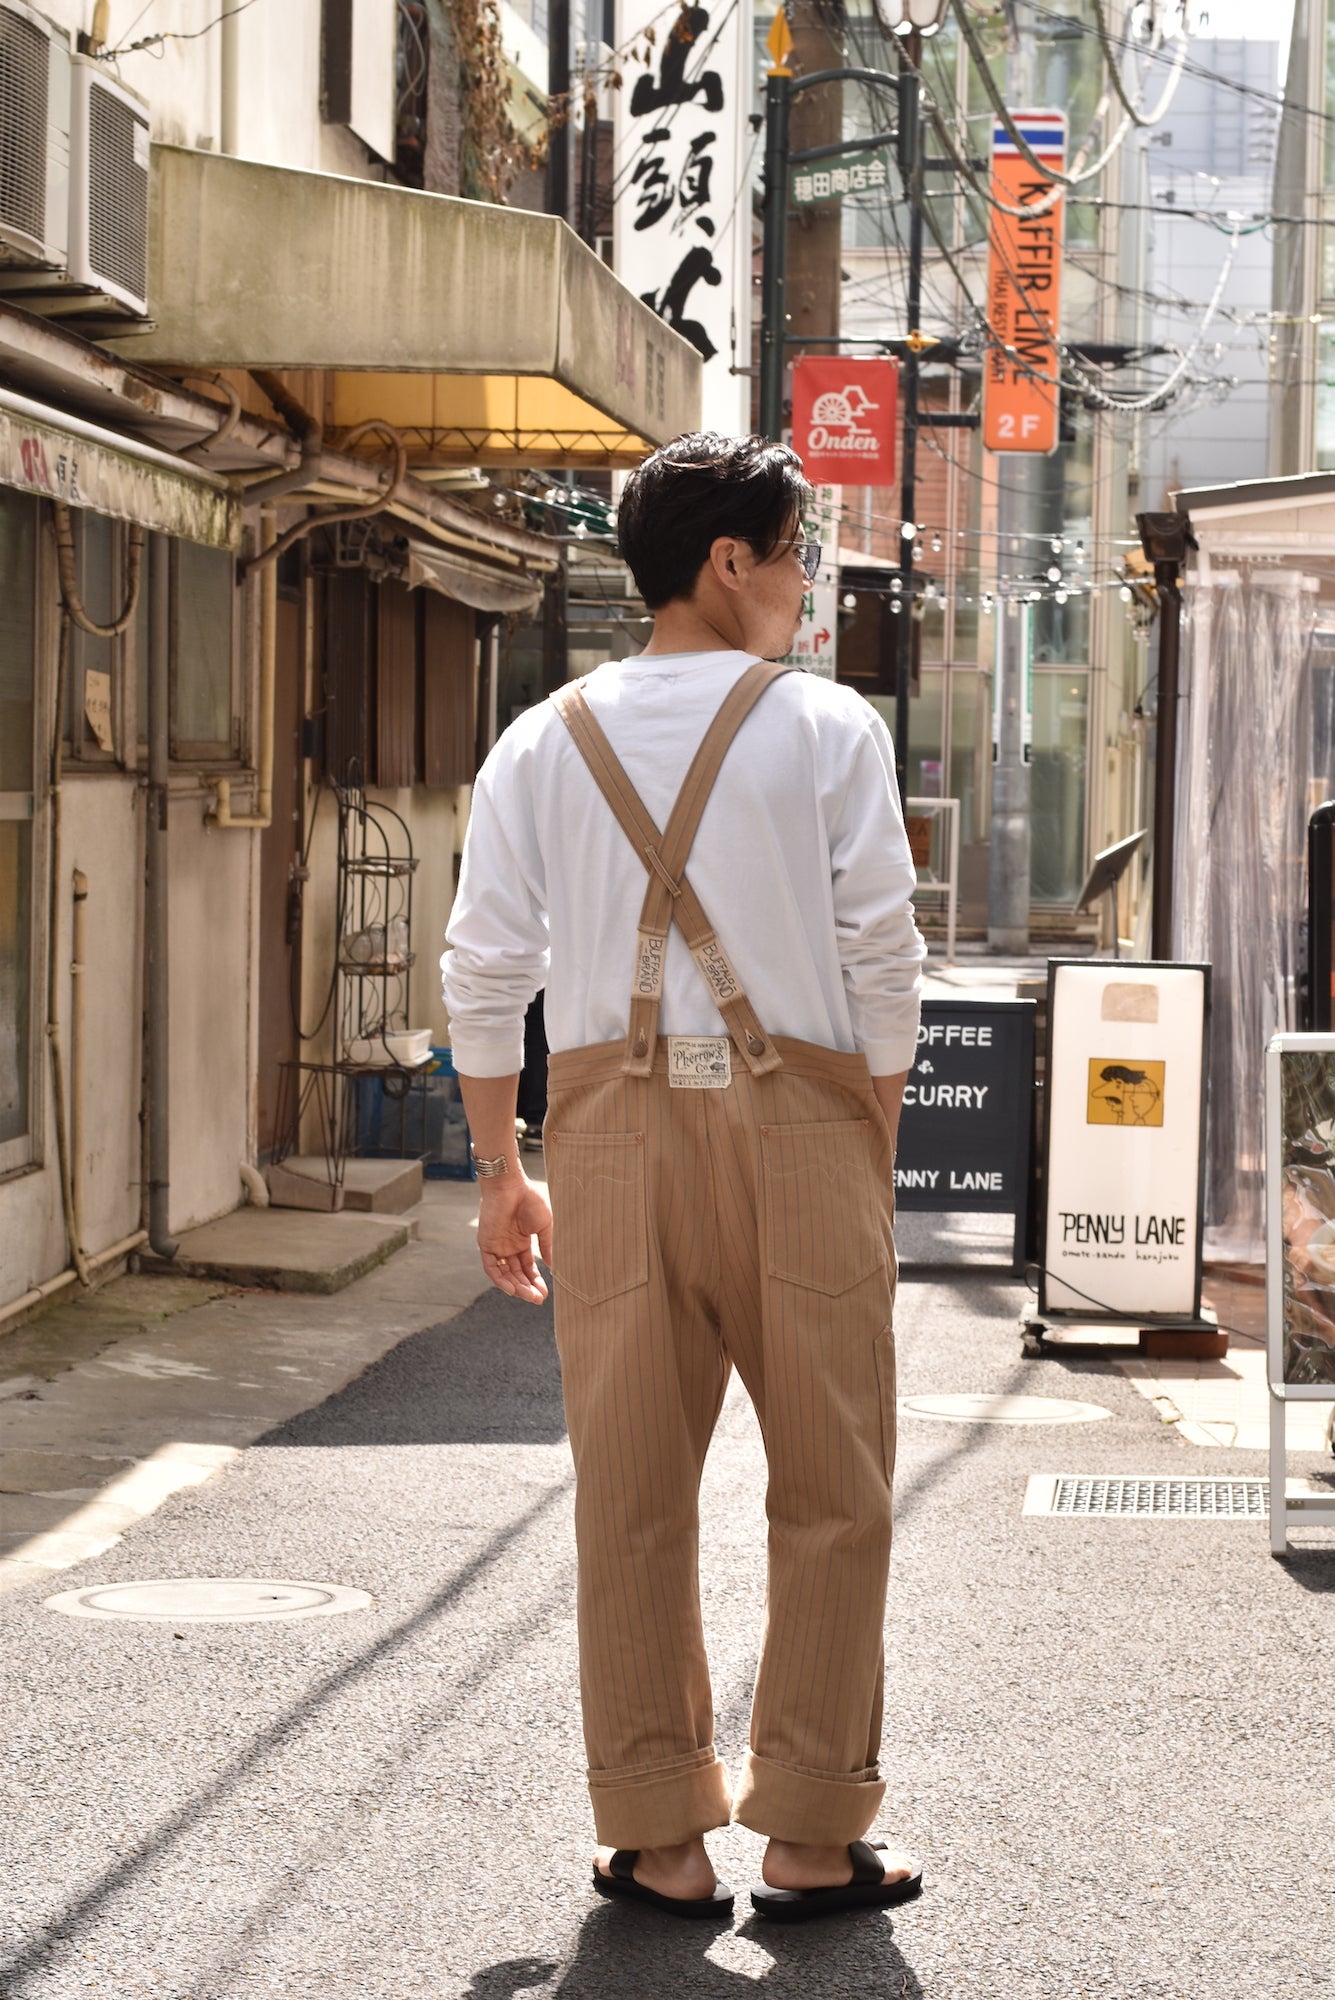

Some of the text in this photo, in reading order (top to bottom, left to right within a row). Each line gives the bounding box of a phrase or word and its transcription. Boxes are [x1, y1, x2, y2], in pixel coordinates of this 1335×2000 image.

[997, 412, 1041, 439] 2F
[808, 427, 879, 451] Onden
[639, 955, 653, 993] BRAND
[649, 938, 663, 985] BUFFALO
[702, 942, 736, 985] BUFFALO
[706, 964, 734, 998] BRAND
[916, 1025, 993, 1047] OFFEE
[917, 1059, 935, 1075] &
[902, 1085, 989, 1109] CURRY
[893, 1169, 1003, 1191] NNY LANE
[1058, 1212, 1186, 1245] PENNY LANE
[1136, 1249, 1180, 1264] harajuku
